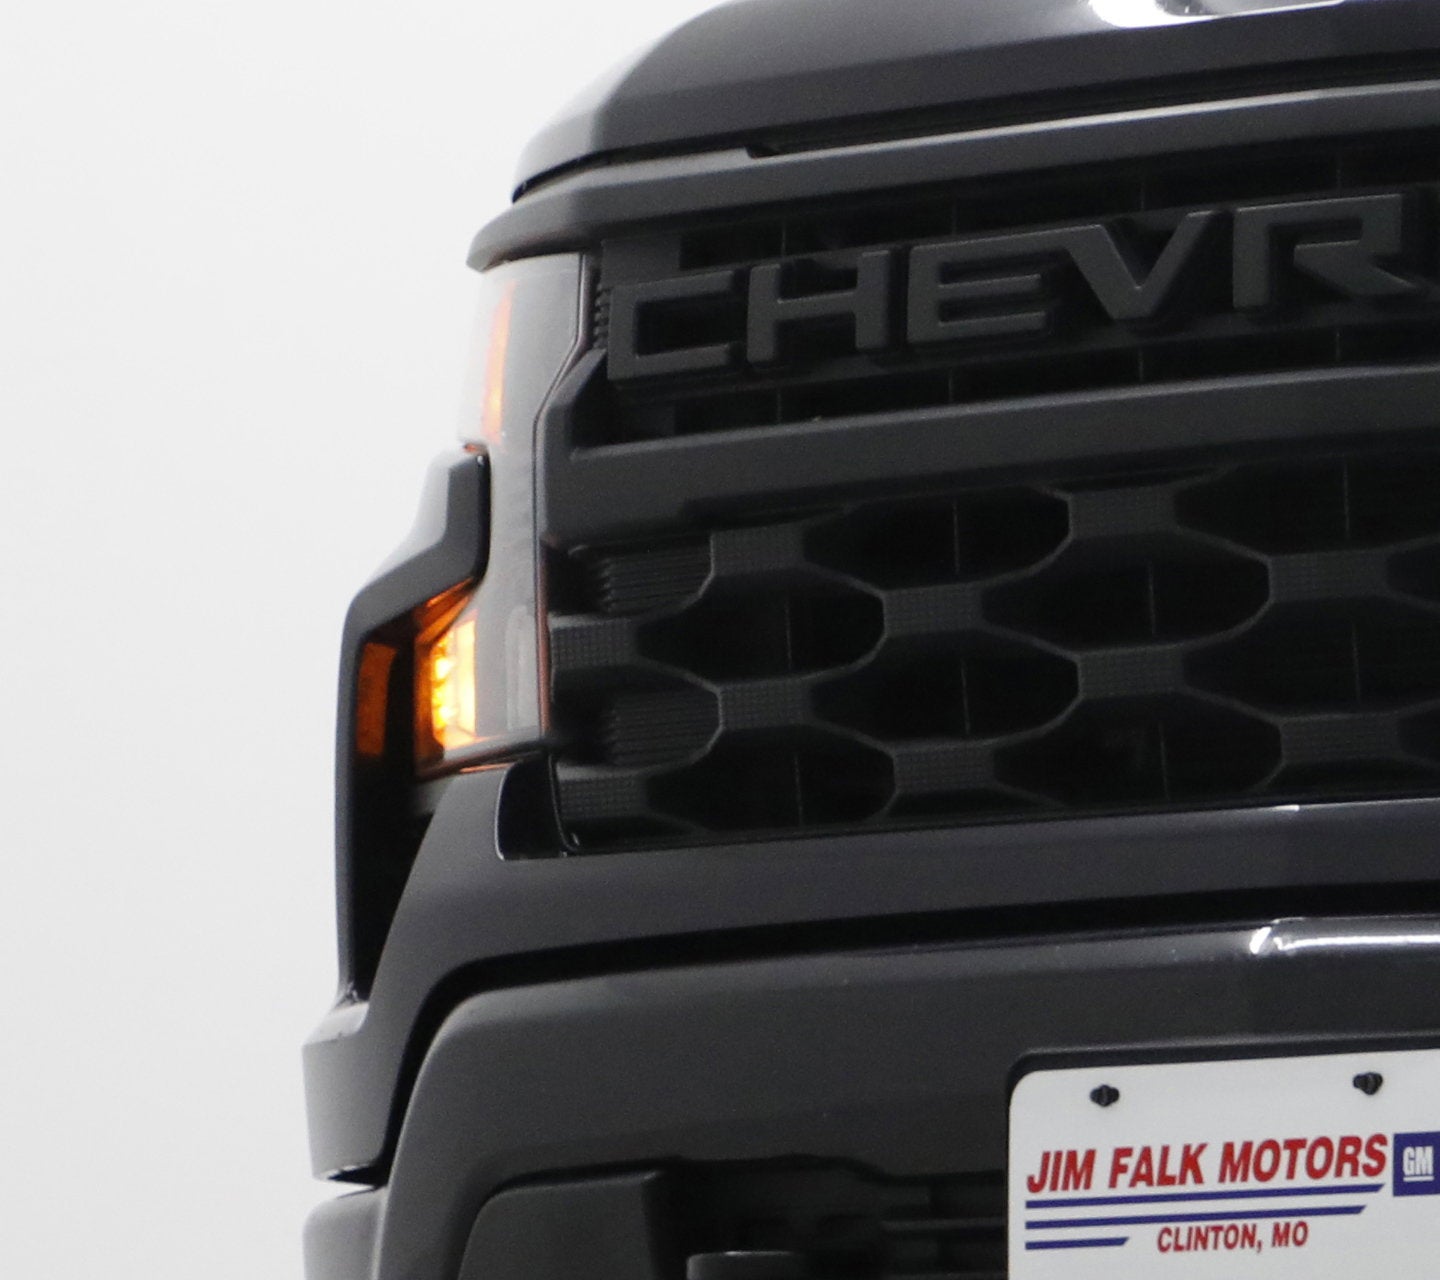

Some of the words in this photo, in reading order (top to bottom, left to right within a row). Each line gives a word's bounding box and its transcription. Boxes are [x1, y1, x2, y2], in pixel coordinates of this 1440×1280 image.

[1026, 1148, 1097, 1193] JIM
[1108, 1143, 1208, 1189] FALK
[1218, 1134, 1388, 1184] MOTORS
[1402, 1144, 1434, 1176] GM
[1157, 1223, 1263, 1254] CLINTON,
[1270, 1221, 1309, 1250] MO
